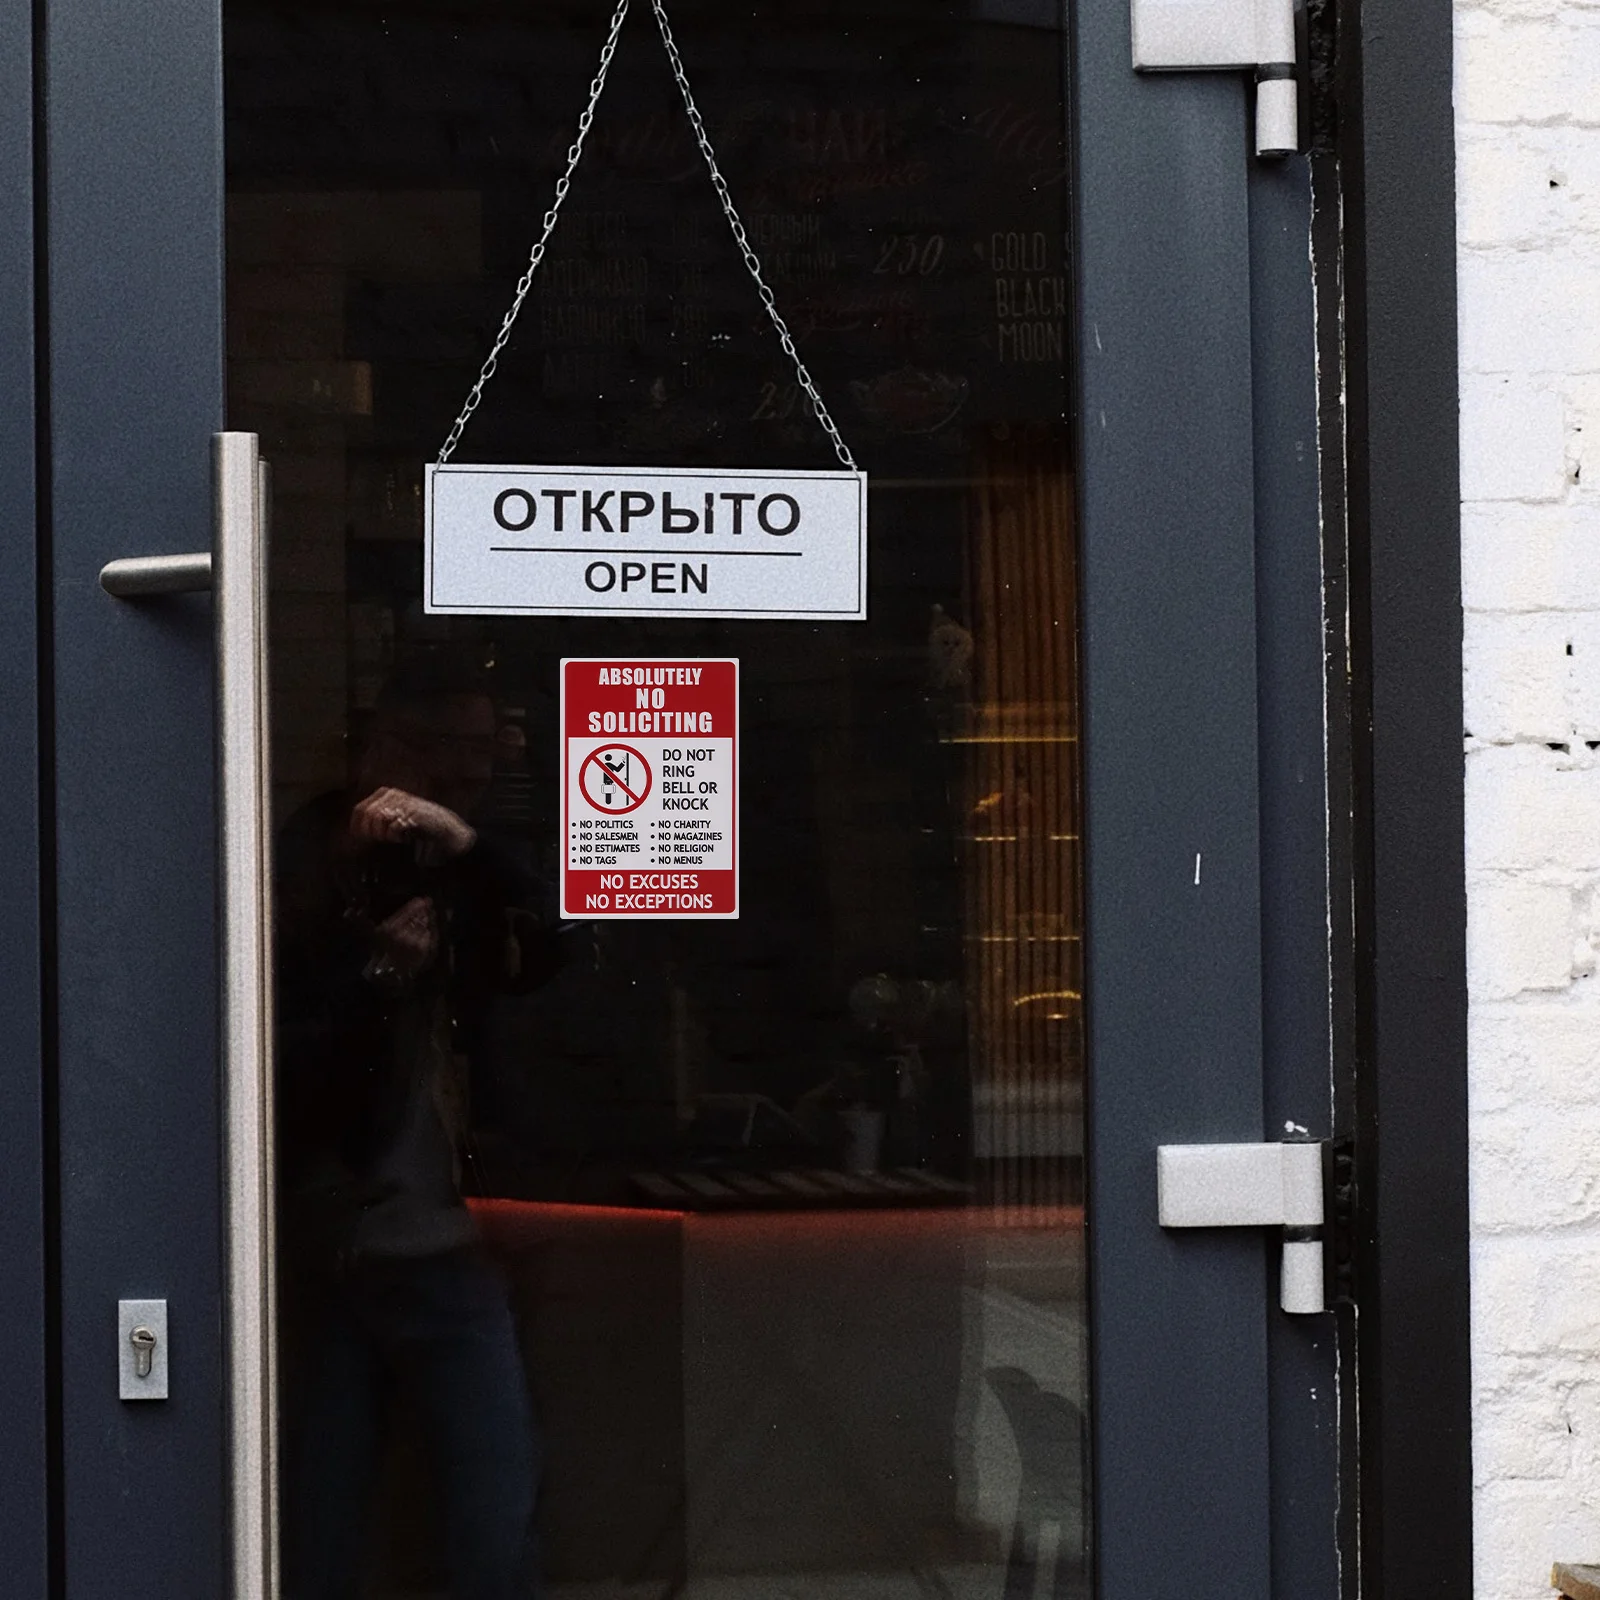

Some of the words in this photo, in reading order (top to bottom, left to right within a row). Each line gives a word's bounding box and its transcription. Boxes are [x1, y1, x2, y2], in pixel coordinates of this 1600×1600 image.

[991, 231, 1047, 272] GOLD
[995, 277, 1066, 318] BLACK
[998, 322, 1063, 362] MOON
[493, 487, 801, 536] ОТКРЫТО
[585, 561, 708, 594] OPEN
[598, 667, 703, 686] ABSOLUTELY
[636, 688, 666, 709] NO
[588, 711, 713, 733] SOLICITING
[662, 749, 682, 761] DO
[686, 749, 716, 761] NOT
[662, 765, 695, 777] RING
[662, 781, 695, 794] BELL
[699, 781, 718, 794] OR
[662, 798, 709, 810] KNOCK
[579, 820, 593, 829] NO
[595, 820, 633, 829] POLITICS
[658, 820, 671, 829] NO
[673, 820, 711, 829] CHARITY
[579, 832, 593, 841] NO
[595, 832, 638, 841] SALESMEN
[658, 832, 671, 841] NO
[673, 832, 722, 841] MAGAZINES
[579, 844, 593, 852] NO
[595, 844, 640, 852] ESTIMATES
[658, 844, 671, 852] NO
[673, 844, 714, 852] RELIGION
[579, 856, 593, 864] NO
[595, 856, 617, 864] TAGS
[658, 856, 671, 864] NO
[673, 856, 703, 864] MENUS
[600, 874, 624, 889] NO
[629, 874, 698, 889] EXCUSES
[586, 894, 610, 909] NO
[615, 894, 713, 909] EXCEPTIONS
